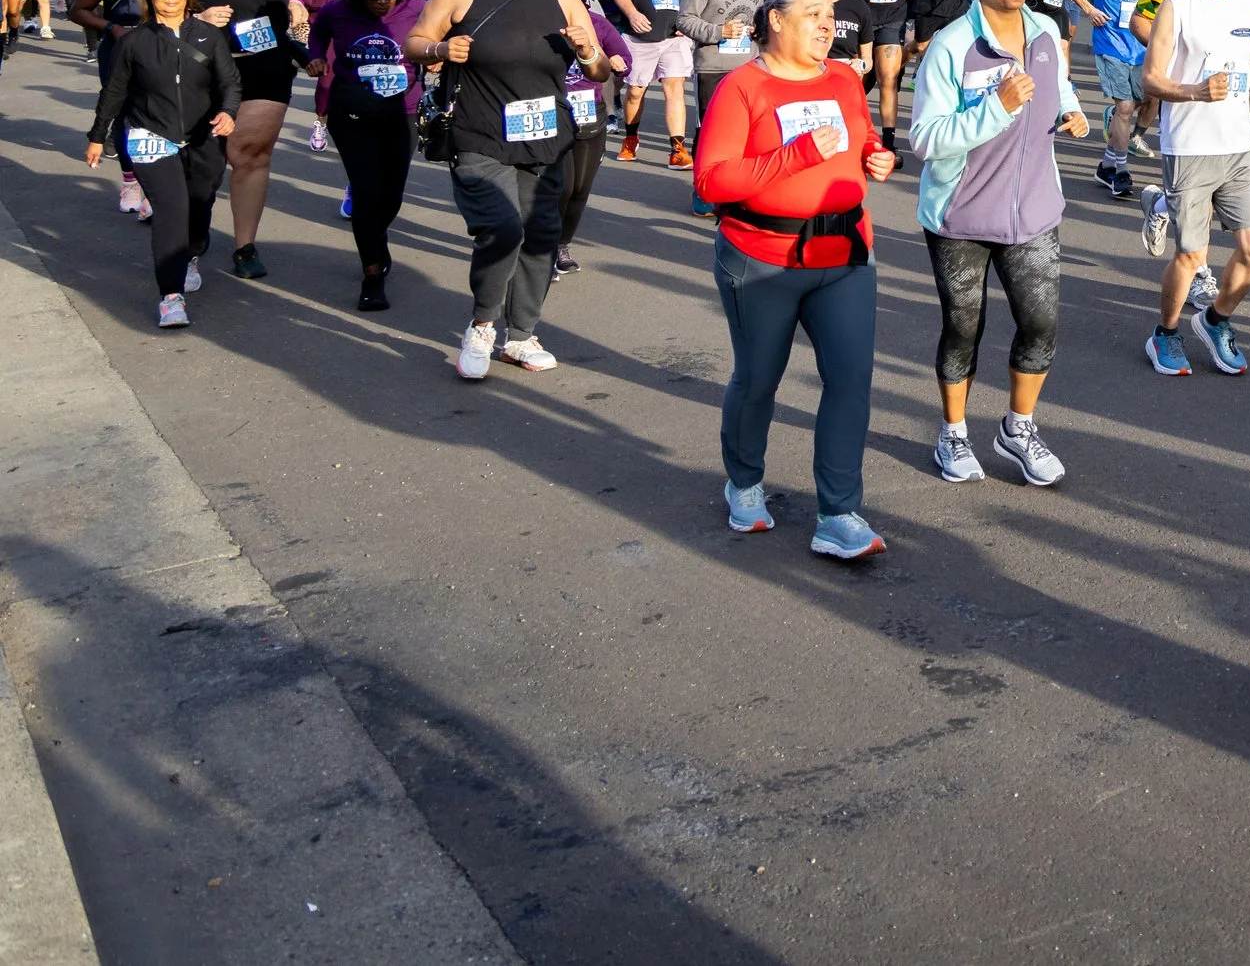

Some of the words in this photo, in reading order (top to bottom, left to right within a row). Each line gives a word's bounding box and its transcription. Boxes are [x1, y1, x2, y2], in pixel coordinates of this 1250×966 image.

[246, 28, 271, 46] 283
[372, 74, 399, 90] 132
[523, 113, 545, 132] 93
[136, 139, 167, 155] 401
